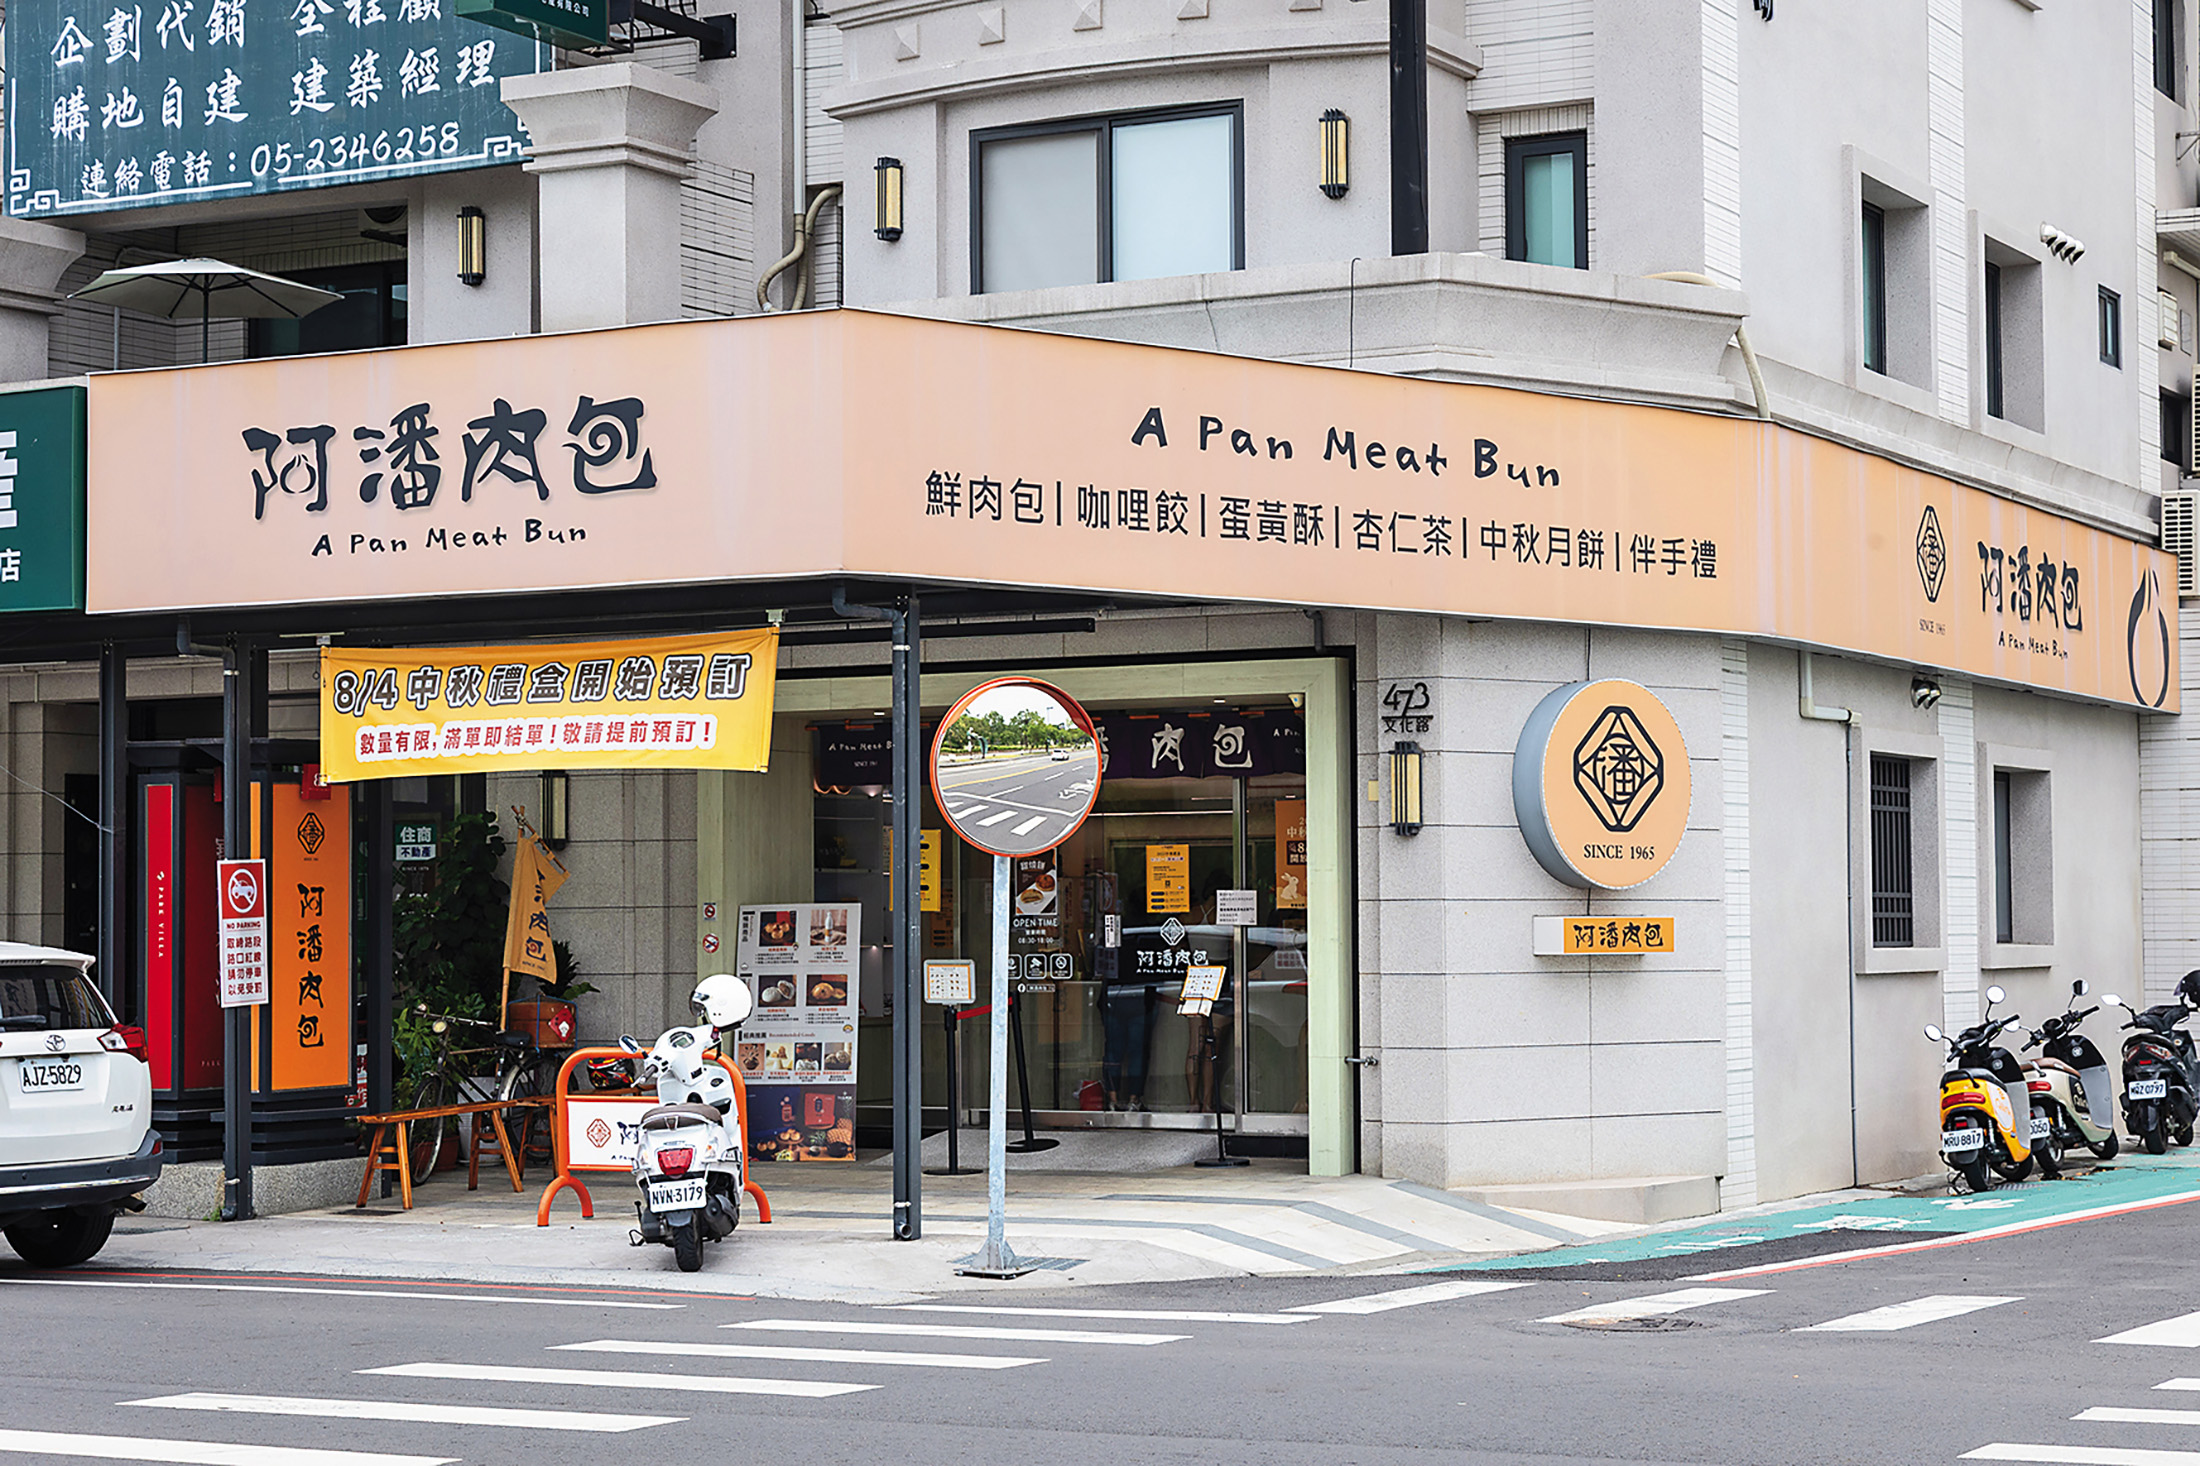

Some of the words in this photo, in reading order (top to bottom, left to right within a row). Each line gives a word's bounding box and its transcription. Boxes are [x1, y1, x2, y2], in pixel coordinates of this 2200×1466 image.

[50, 67, 249, 142] 購地自建
[290, 40, 495, 115] 建築經理
[242, 395, 658, 521] 阿潘肉包
[1131, 407, 1168, 447] A
[1199, 416, 1293, 460] Pan
[1323, 426, 1448, 477] Meat
[1473, 438, 1560, 488] Bun
[312, 535, 332, 557] A
[351, 534, 407, 555] Pan
[426, 526, 507, 550] Meat
[525, 519, 587, 544] Bun
[925, 470, 1044, 525] 鮮肉包
[1078, 483, 1189, 536] 咖哩餃
[1219, 496, 1324, 547] 蛋黃酥
[1352, 508, 1452, 557] 杏仁茶
[1480, 520, 1605, 570] 中秋月餅
[1629, 533, 1718, 579] 伴手禮
[1977, 541, 2083, 632] 阿潘肉包
[1998, 631, 2005, 647] A
[2009, 634, 2024, 650] Pan
[2028, 637, 2049, 655] Meat
[2052, 639, 2068, 660] Bun
[1382, 681, 1430, 717] 473
[400, 826, 432, 843] 住商
[1583, 843, 1624, 860] SINCE
[1630, 845, 1655, 861] 1965
[236, 921, 262, 929] PARKING
[1012, 918, 1037, 928] OPEN
[1038, 918, 1058, 928] TIME
[1573, 921, 1665, 949] 阿潘肉包
[297, 882, 324, 1048] 阿潘肉包
[22, 1064, 82, 1088] AJZ-5829
[652, 1186, 704, 1206] NVN-3179
